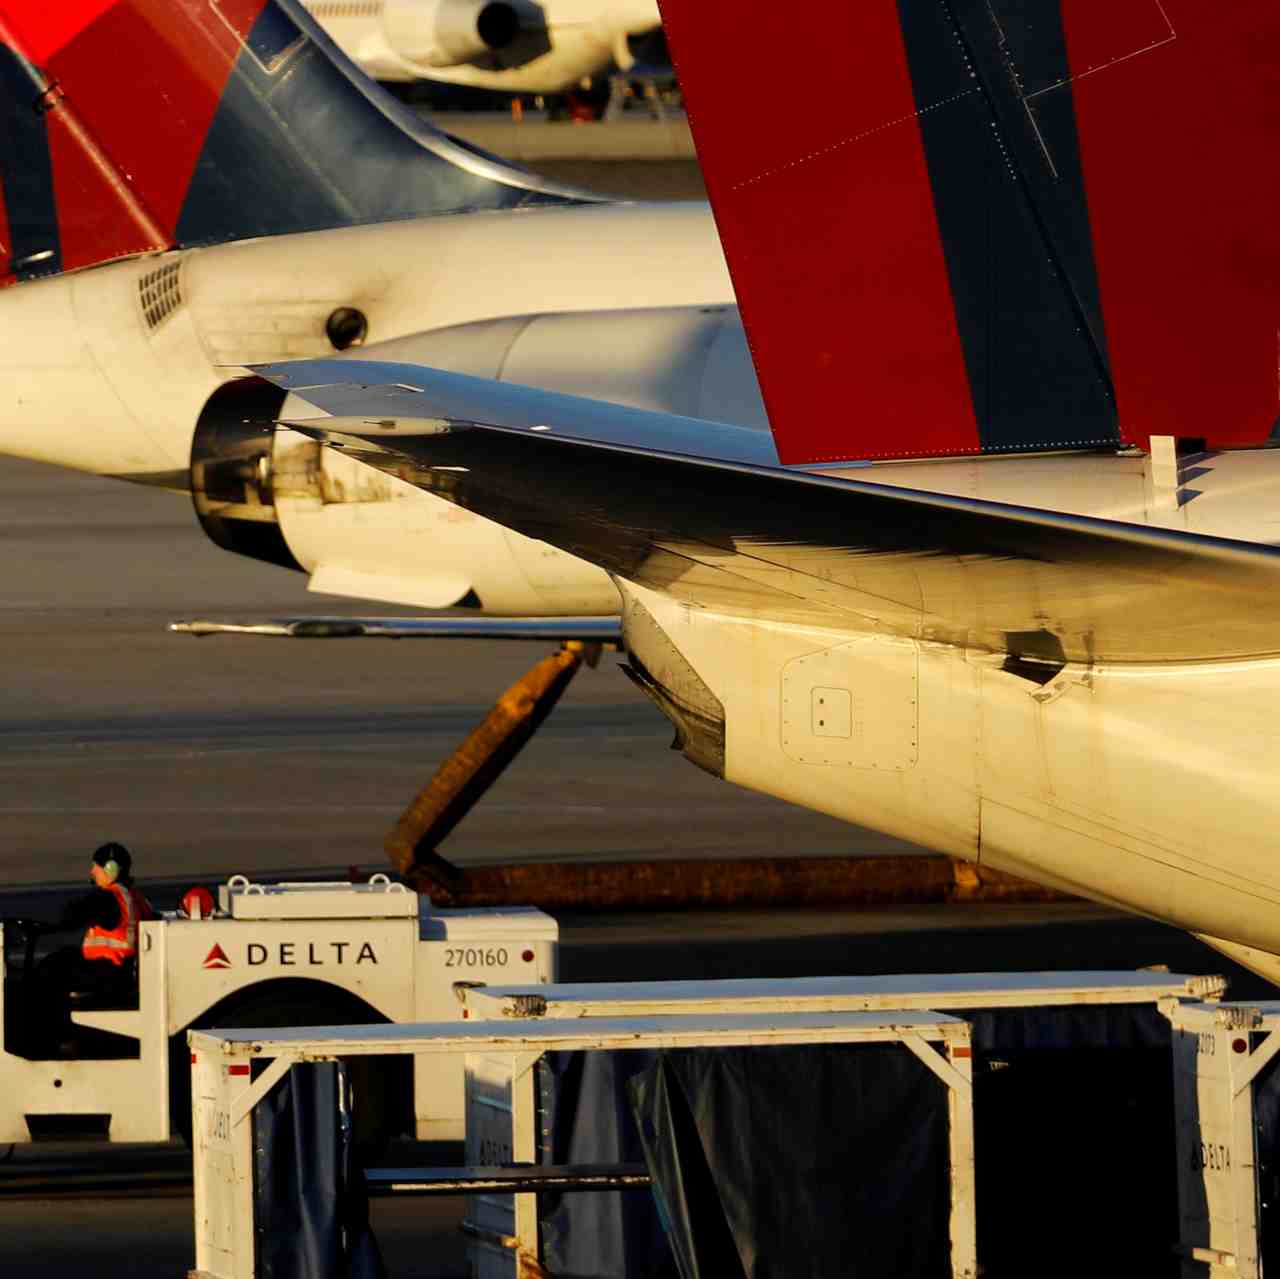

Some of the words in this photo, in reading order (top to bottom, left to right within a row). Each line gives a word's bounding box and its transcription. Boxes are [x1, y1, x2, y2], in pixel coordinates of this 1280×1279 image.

[247, 942, 378, 966] DELTA
[445, 948, 508, 967] 270160
[1201, 1142, 1231, 1174] DELTA
